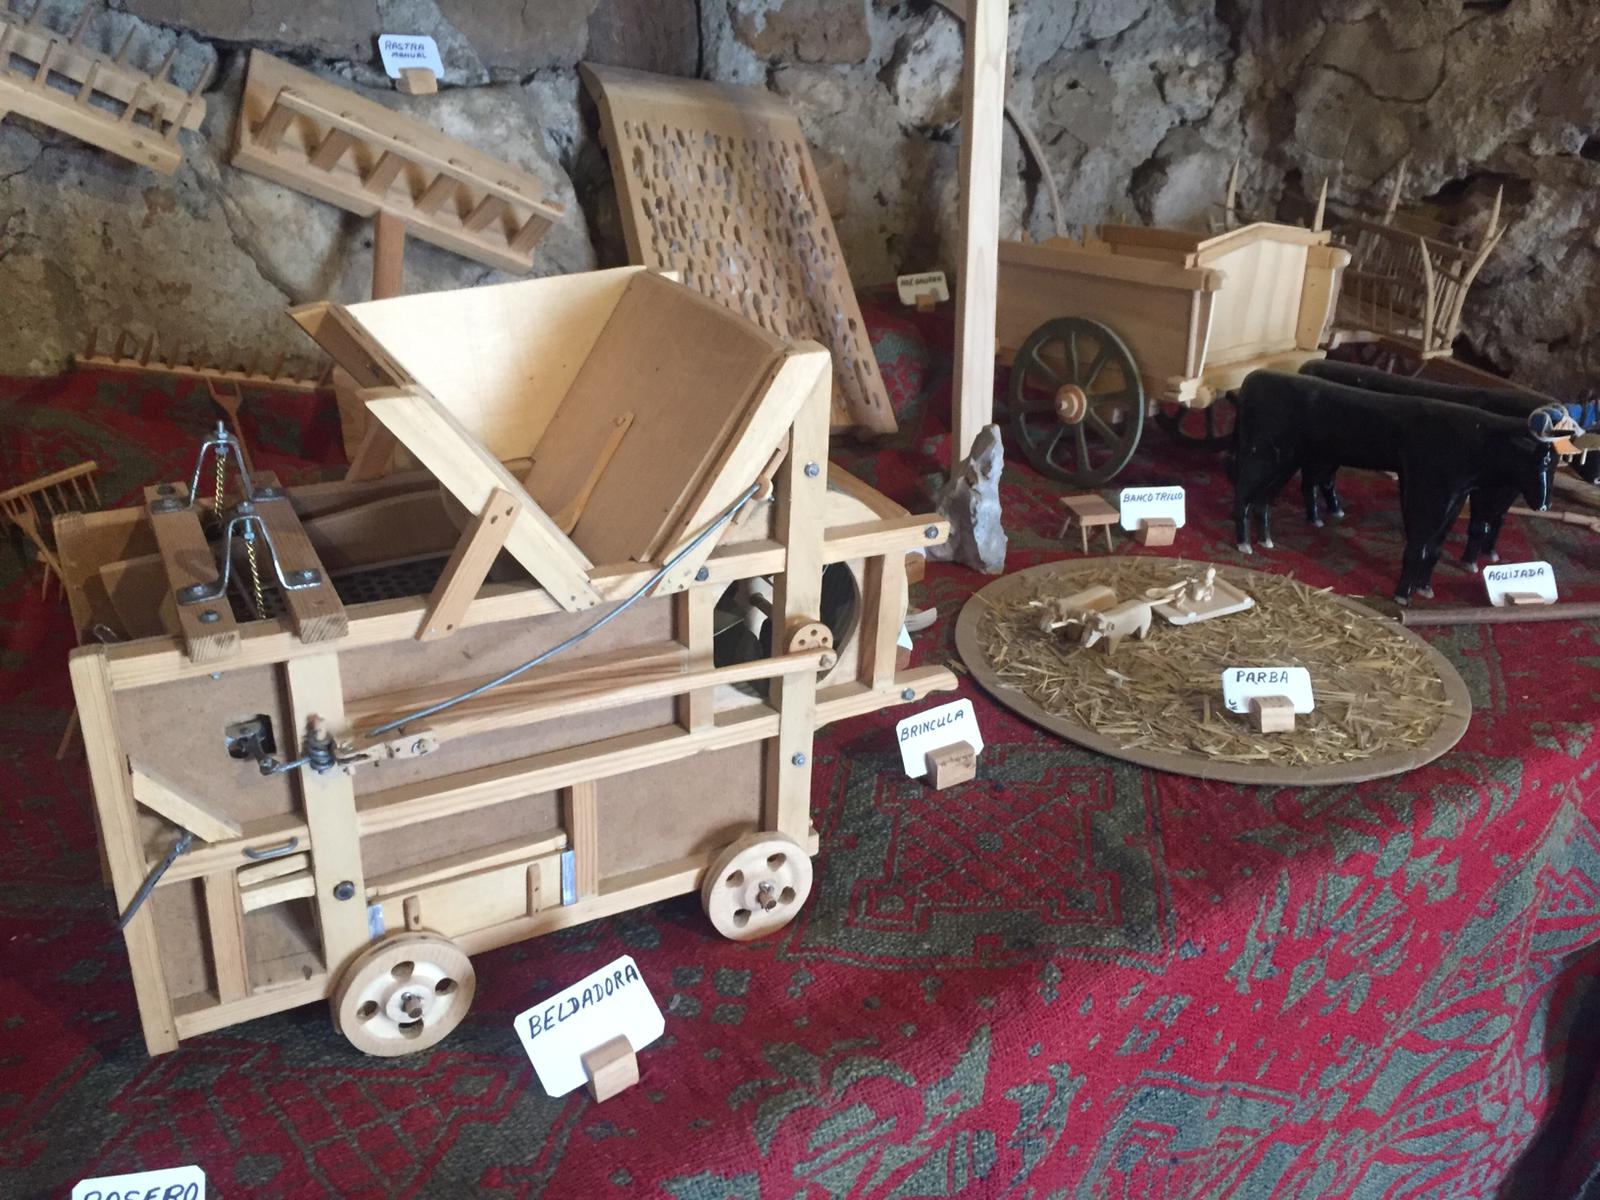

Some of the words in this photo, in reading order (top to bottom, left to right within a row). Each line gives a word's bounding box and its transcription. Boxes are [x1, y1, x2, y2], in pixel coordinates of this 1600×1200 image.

[384, 40, 425, 51] RASTRA
[1123, 493, 1154, 503] BANCO
[1154, 491, 1184, 502] TRILLO
[1488, 567, 1545, 581] AGUIJADA
[1236, 670, 1289, 685] PARBA
[900, 709, 965, 742] BRINCULA
[528, 964, 639, 1039] BELDADORA
